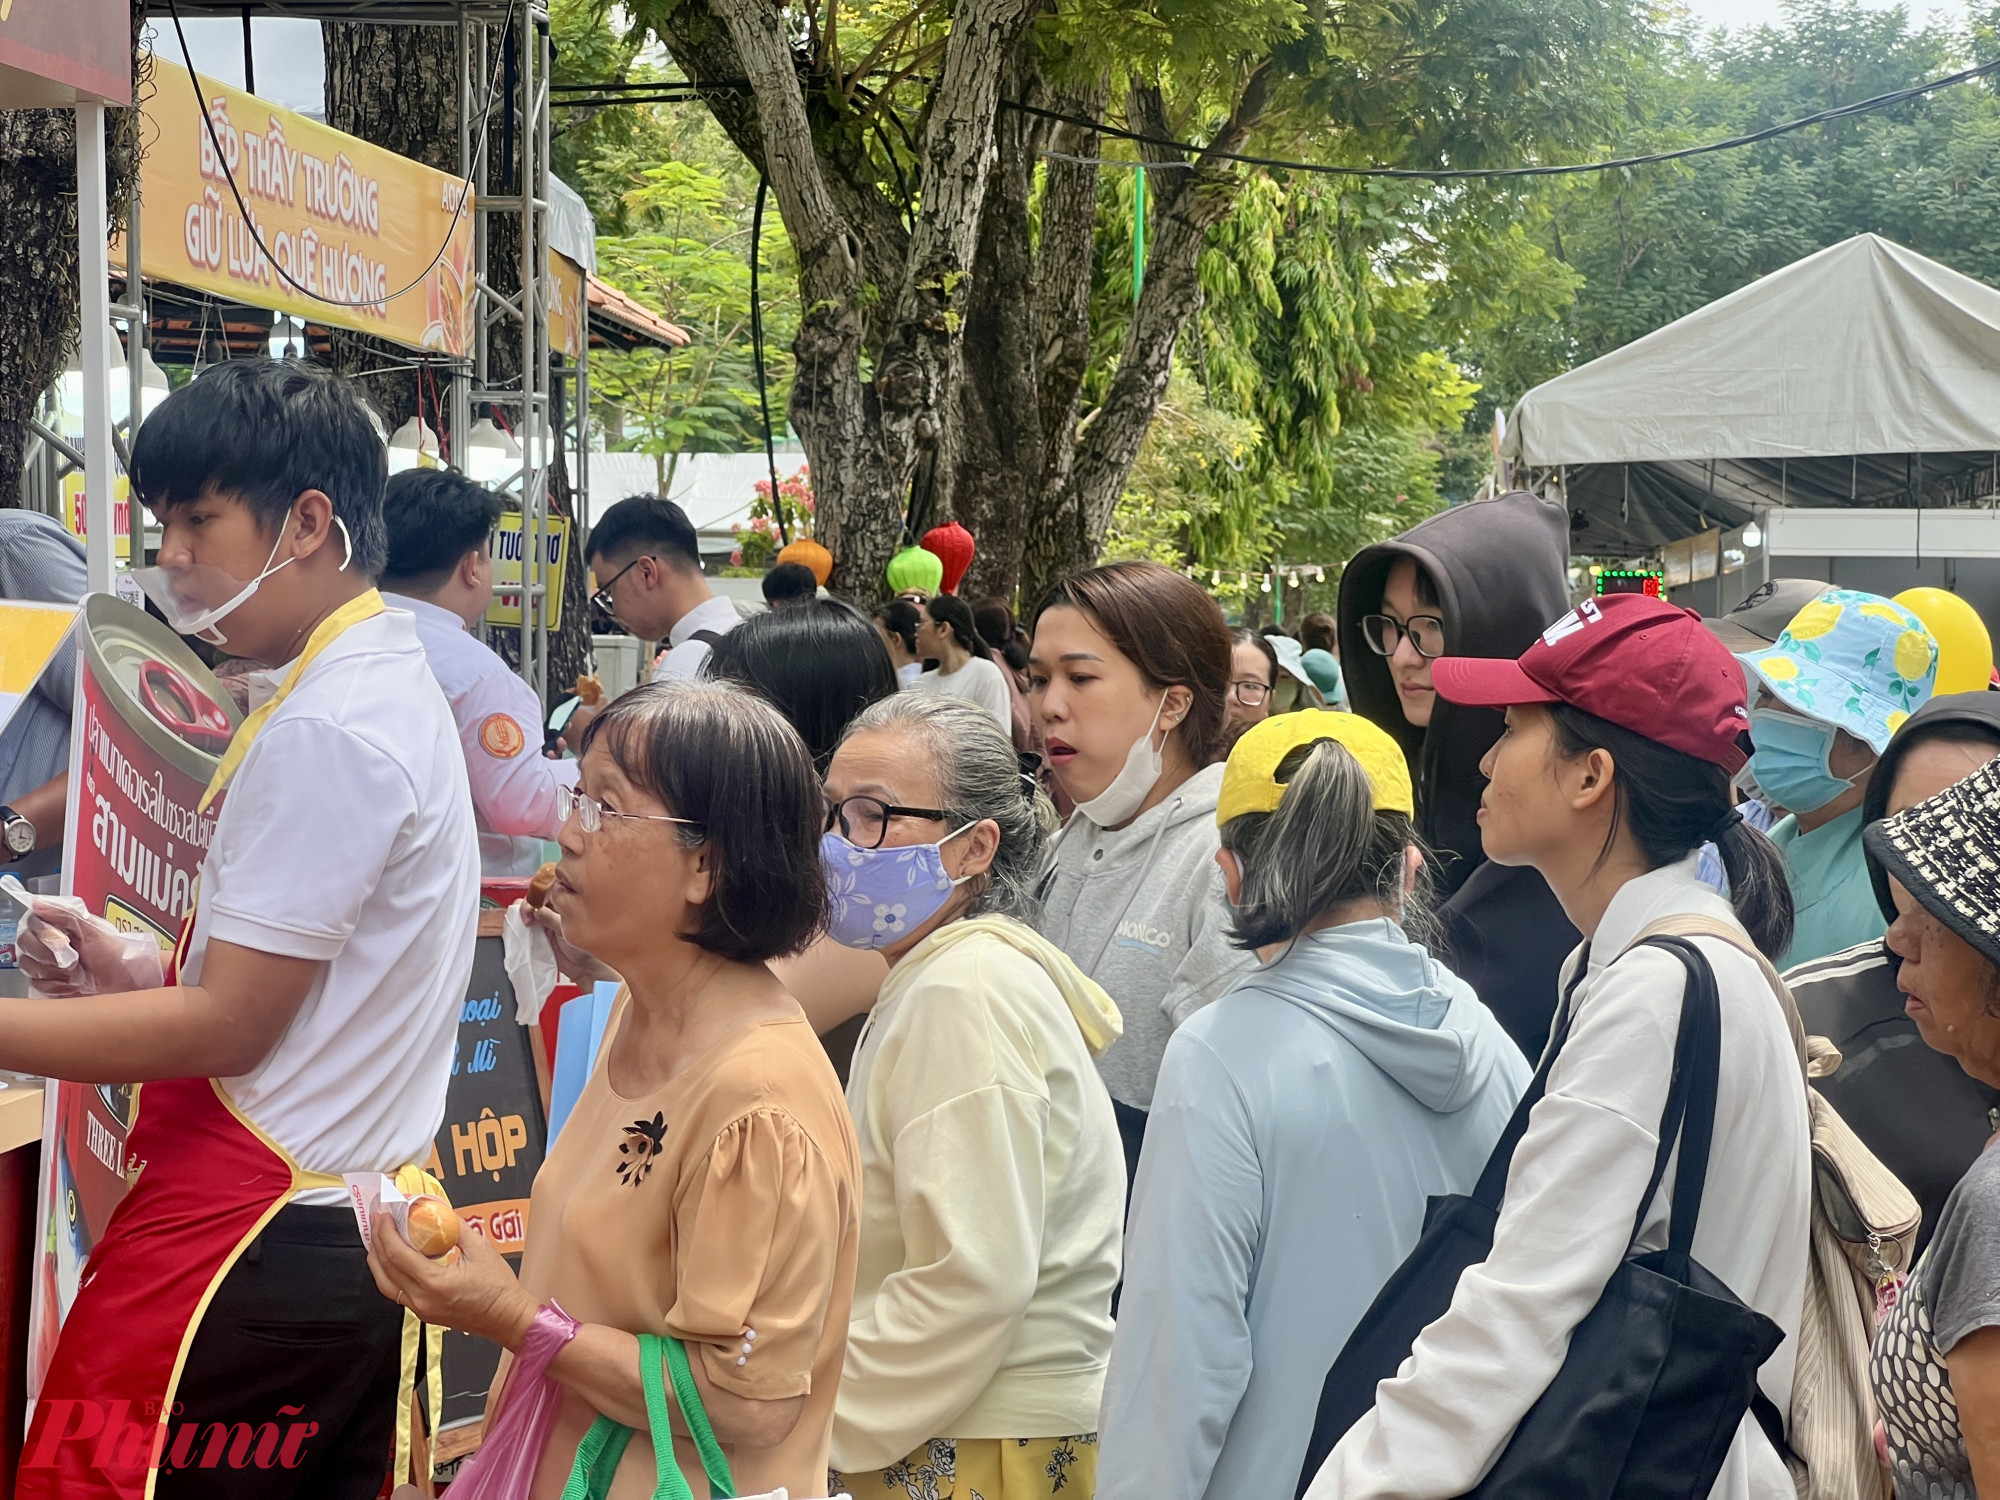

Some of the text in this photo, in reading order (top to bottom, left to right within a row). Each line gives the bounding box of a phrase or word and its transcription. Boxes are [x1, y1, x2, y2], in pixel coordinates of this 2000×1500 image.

[200, 96, 379, 236] BẾP THẦY TRƯỜNG
[185, 186, 387, 318] GIỮ LỬA QUÊ HƯƠNG
[86, 1109, 116, 1172] THREE
[451, 1107, 527, 1183] HỘP
